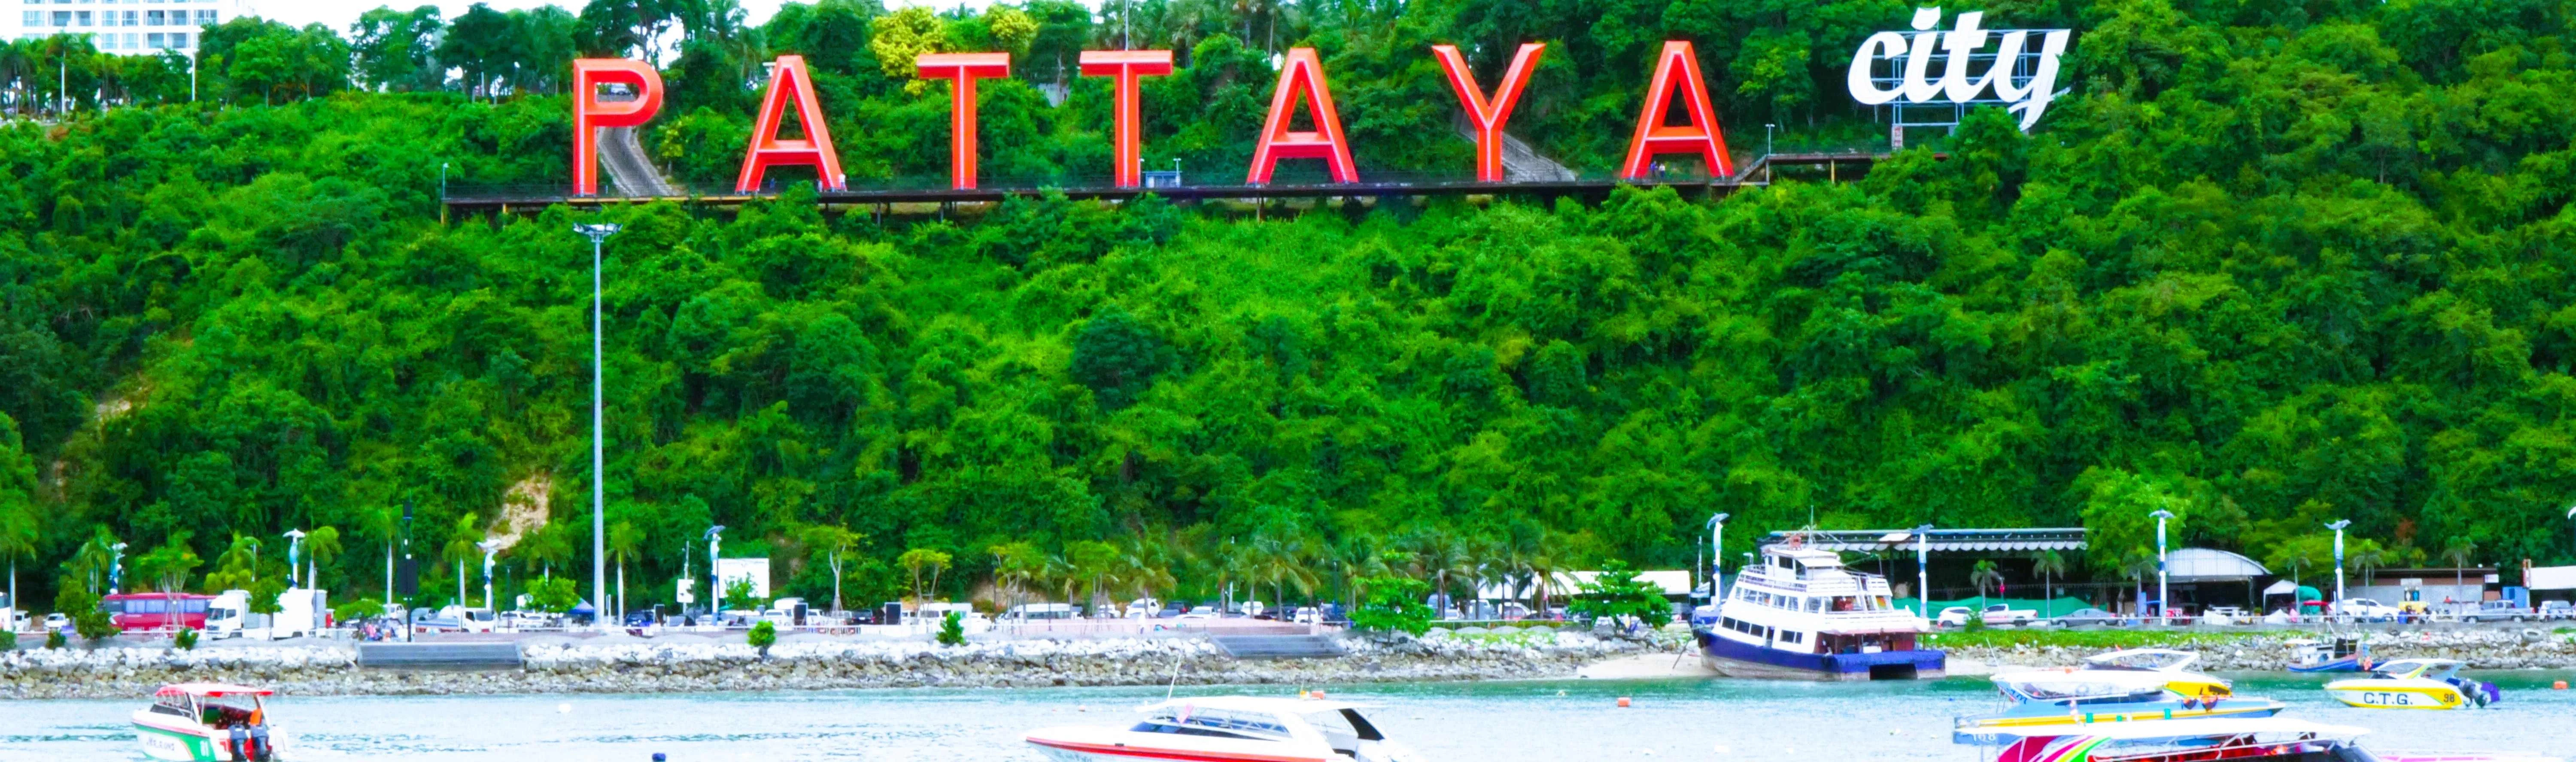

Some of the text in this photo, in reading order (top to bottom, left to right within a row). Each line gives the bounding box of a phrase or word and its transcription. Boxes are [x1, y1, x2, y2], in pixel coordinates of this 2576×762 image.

[574, 6, 2071, 196] PATTAYA city
[2364, 692, 2413, 705] C.T.G.
